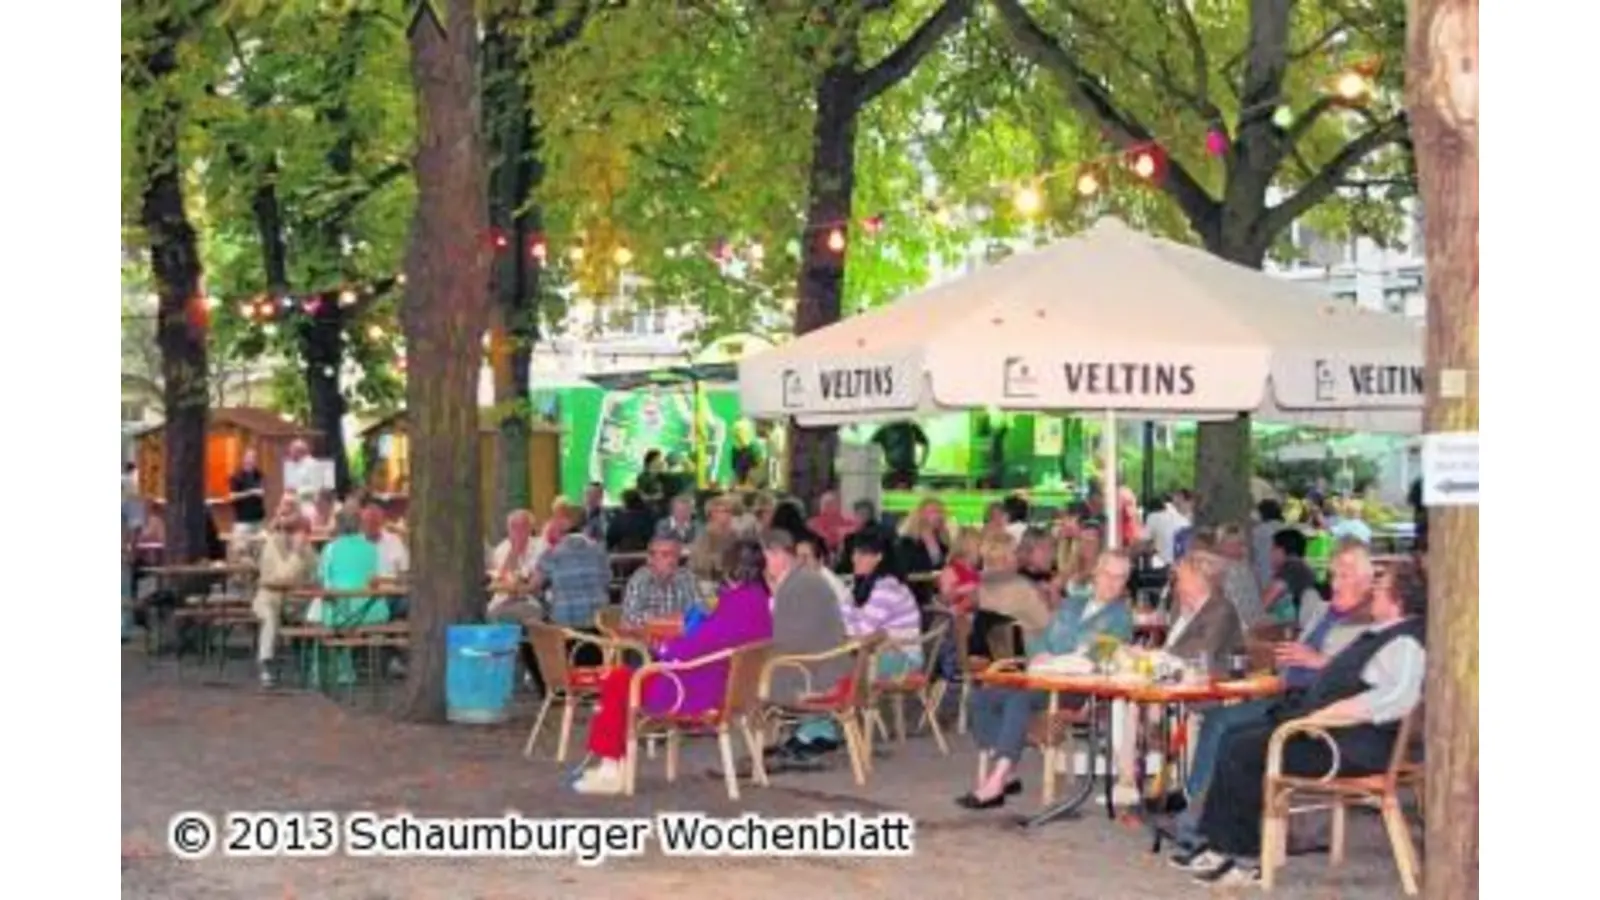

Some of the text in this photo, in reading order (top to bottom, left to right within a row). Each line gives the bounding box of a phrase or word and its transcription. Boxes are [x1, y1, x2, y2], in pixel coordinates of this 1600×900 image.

[819, 366, 893, 399] VELTINS
[1064, 363, 1195, 394] VELTINS
[1349, 365, 1423, 394] VELTIN
